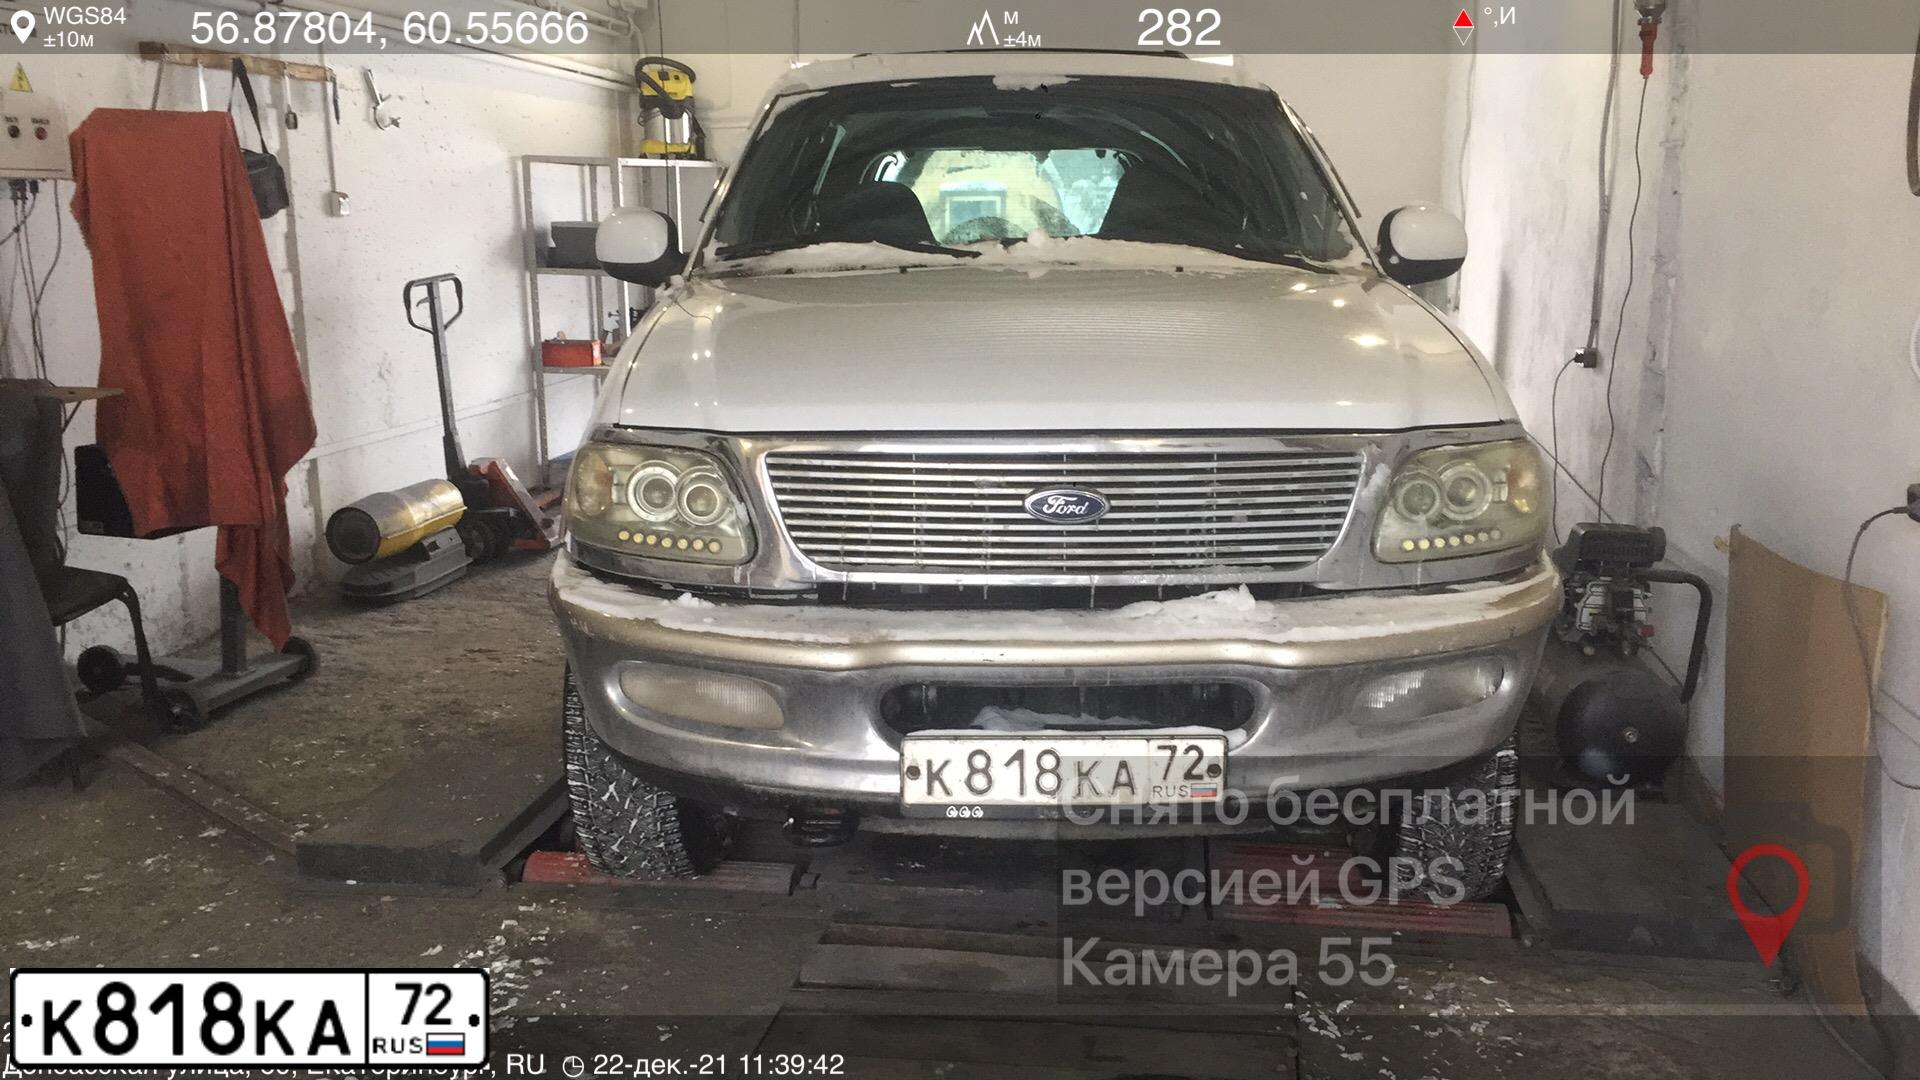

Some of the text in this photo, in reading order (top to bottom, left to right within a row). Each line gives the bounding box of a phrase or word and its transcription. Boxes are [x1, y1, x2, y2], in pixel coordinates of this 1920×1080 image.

[1042, 495, 1089, 514] Ford
[1157, 745, 1204, 781] 72
[1153, 785, 1189, 799] RUS
